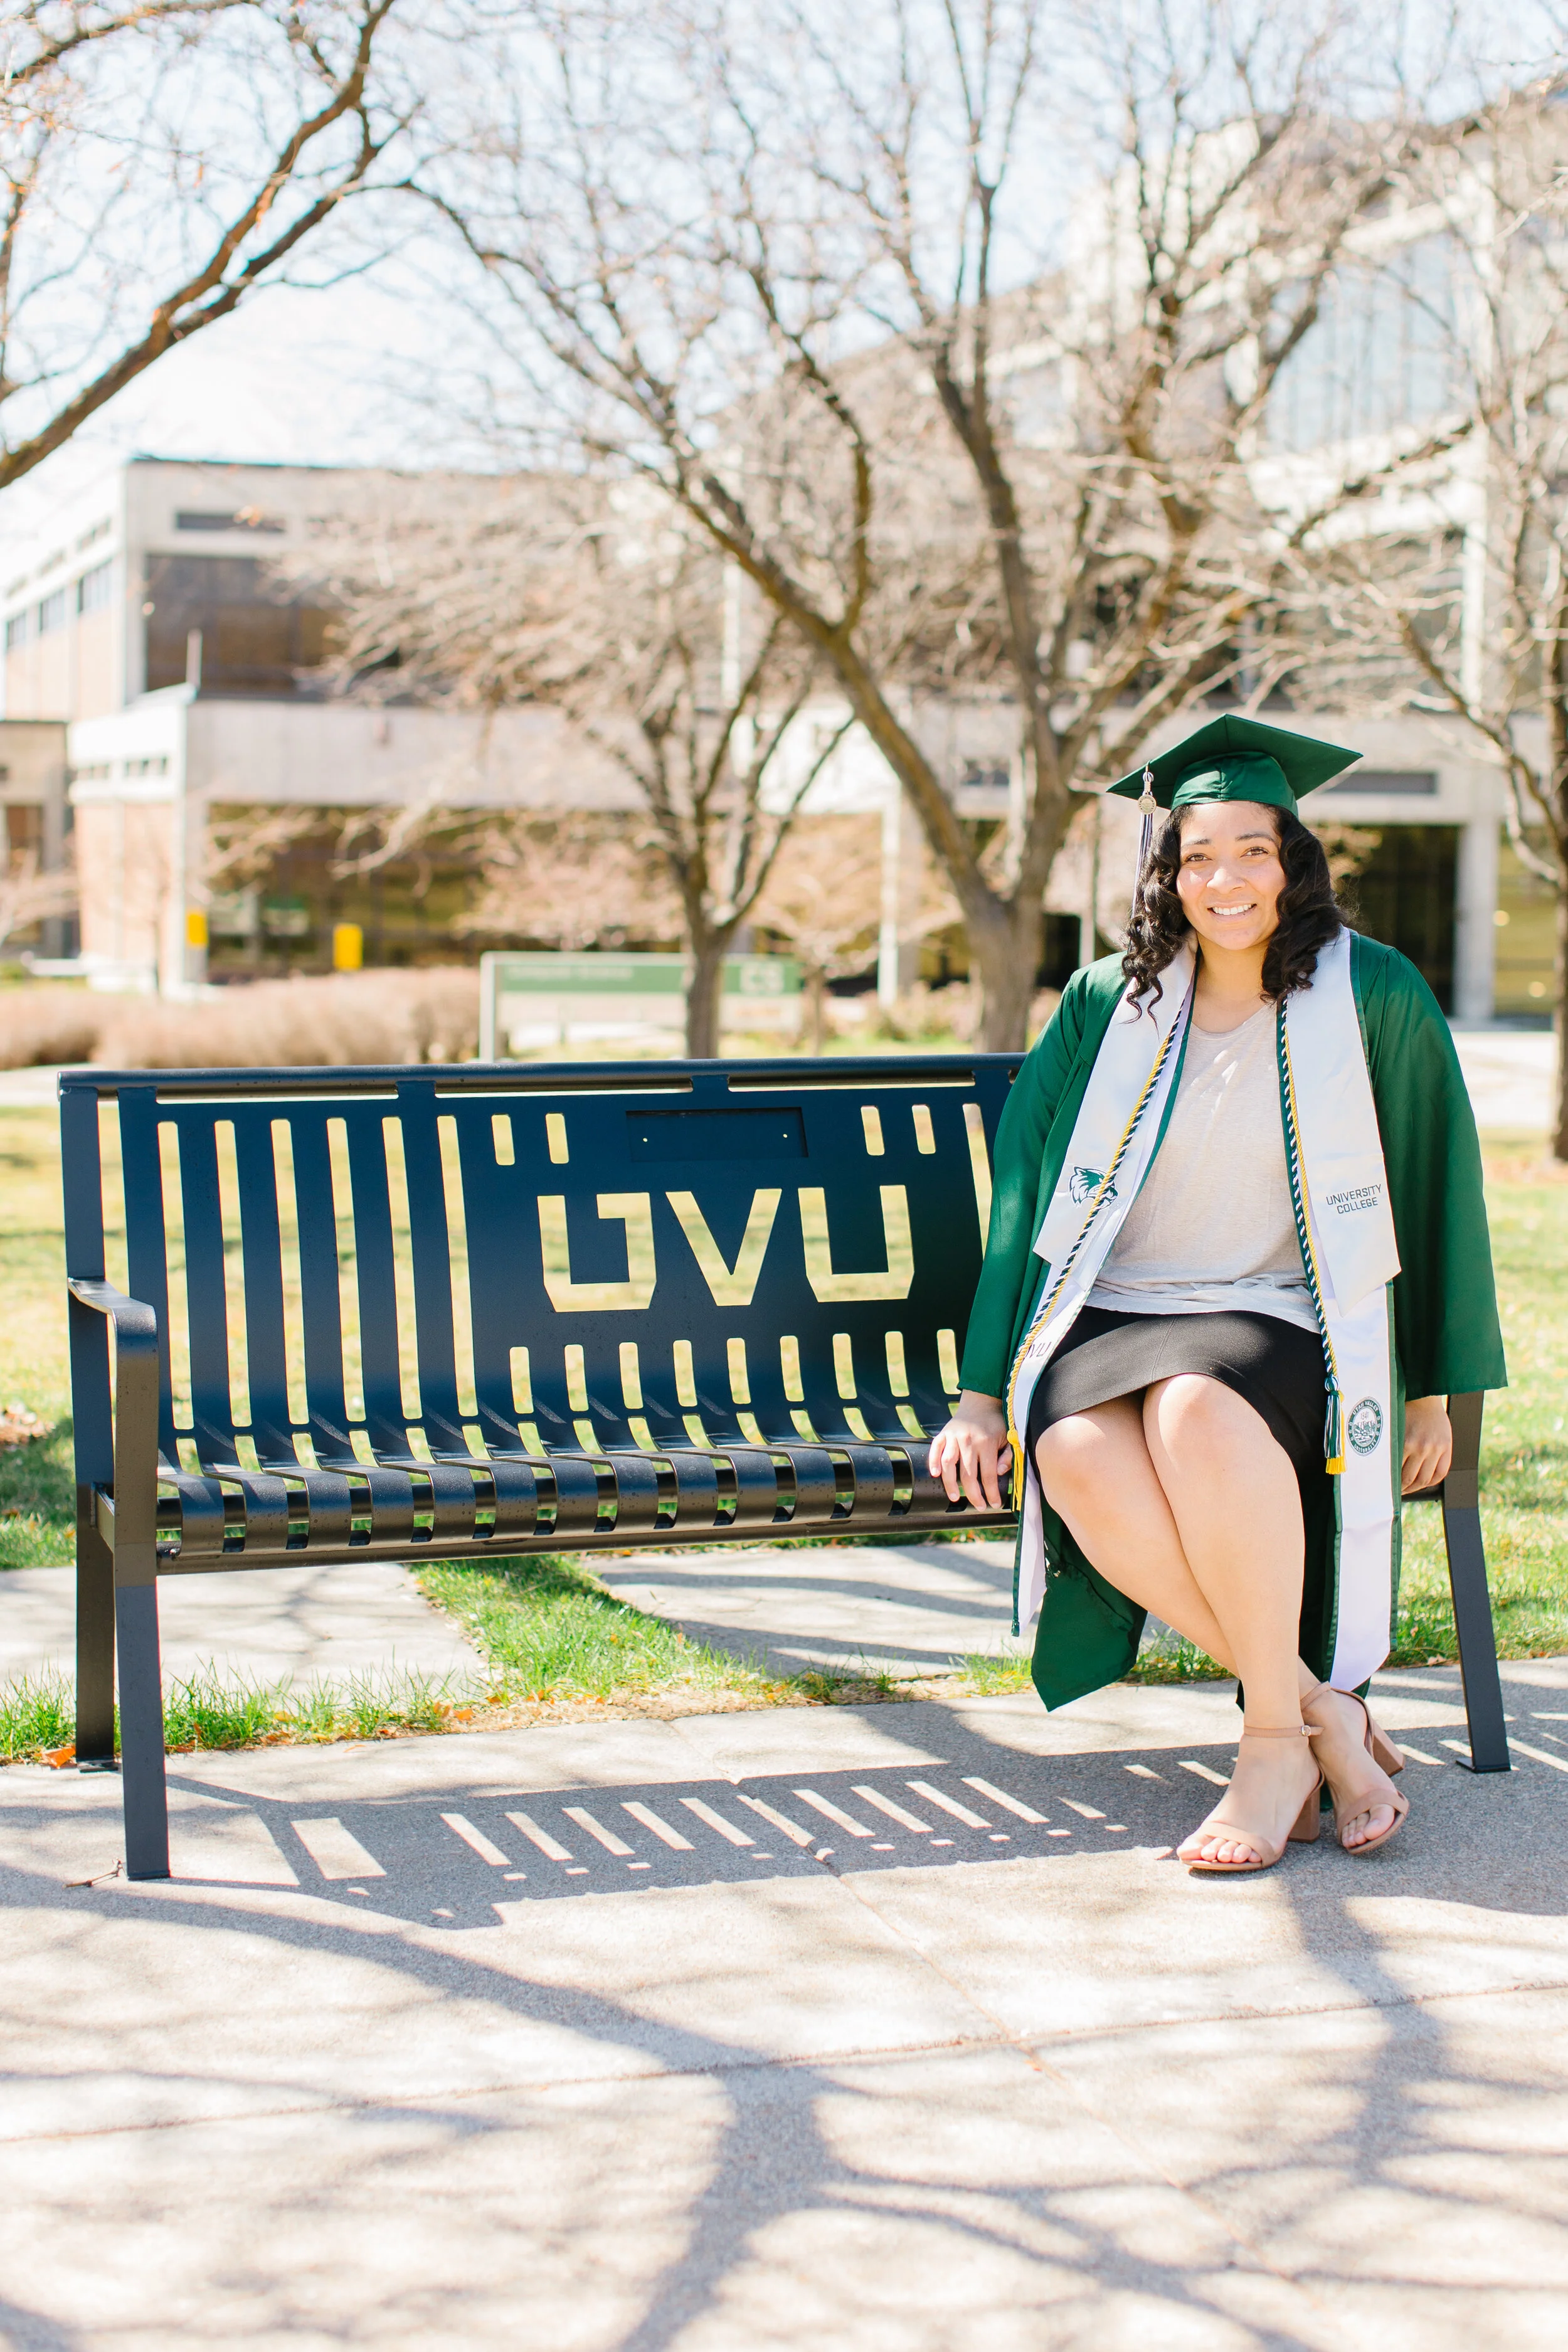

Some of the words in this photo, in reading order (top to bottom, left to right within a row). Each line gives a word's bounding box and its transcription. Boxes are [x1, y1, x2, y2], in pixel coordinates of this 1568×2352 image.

[1326, 1184, 1381, 1205] UNIVERSITY
[1337, 1197, 1379, 1214] COLLEGE
[1025, 1342, 1052, 1358] VU
